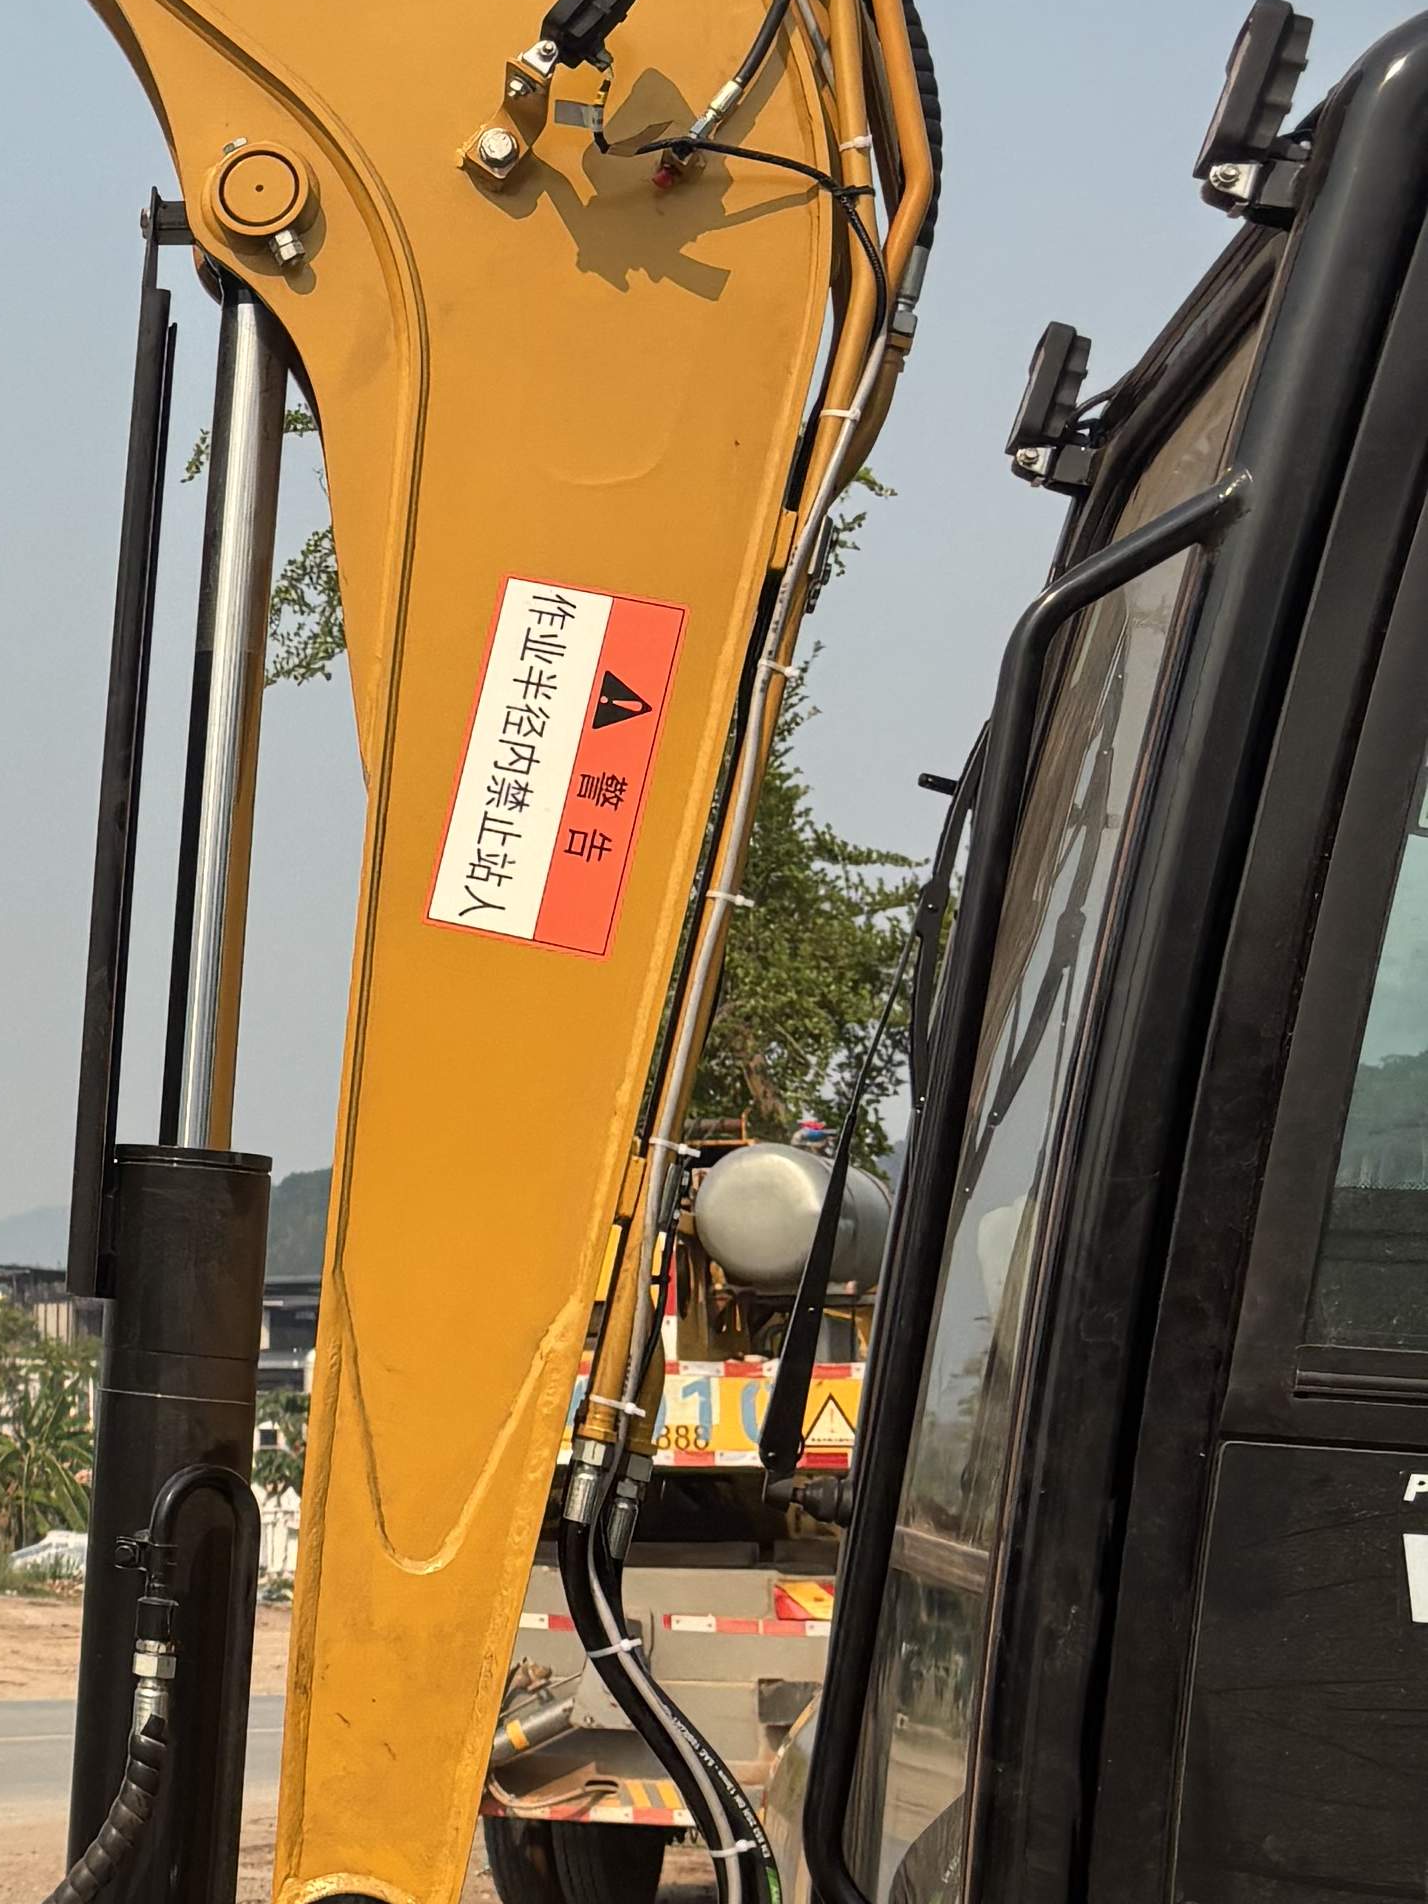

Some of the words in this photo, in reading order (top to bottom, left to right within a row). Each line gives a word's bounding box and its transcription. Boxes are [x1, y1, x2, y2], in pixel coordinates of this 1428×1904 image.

[458, 591, 577, 917] 作业半径内禁止站人
[563, 770, 629, 864] 警告
